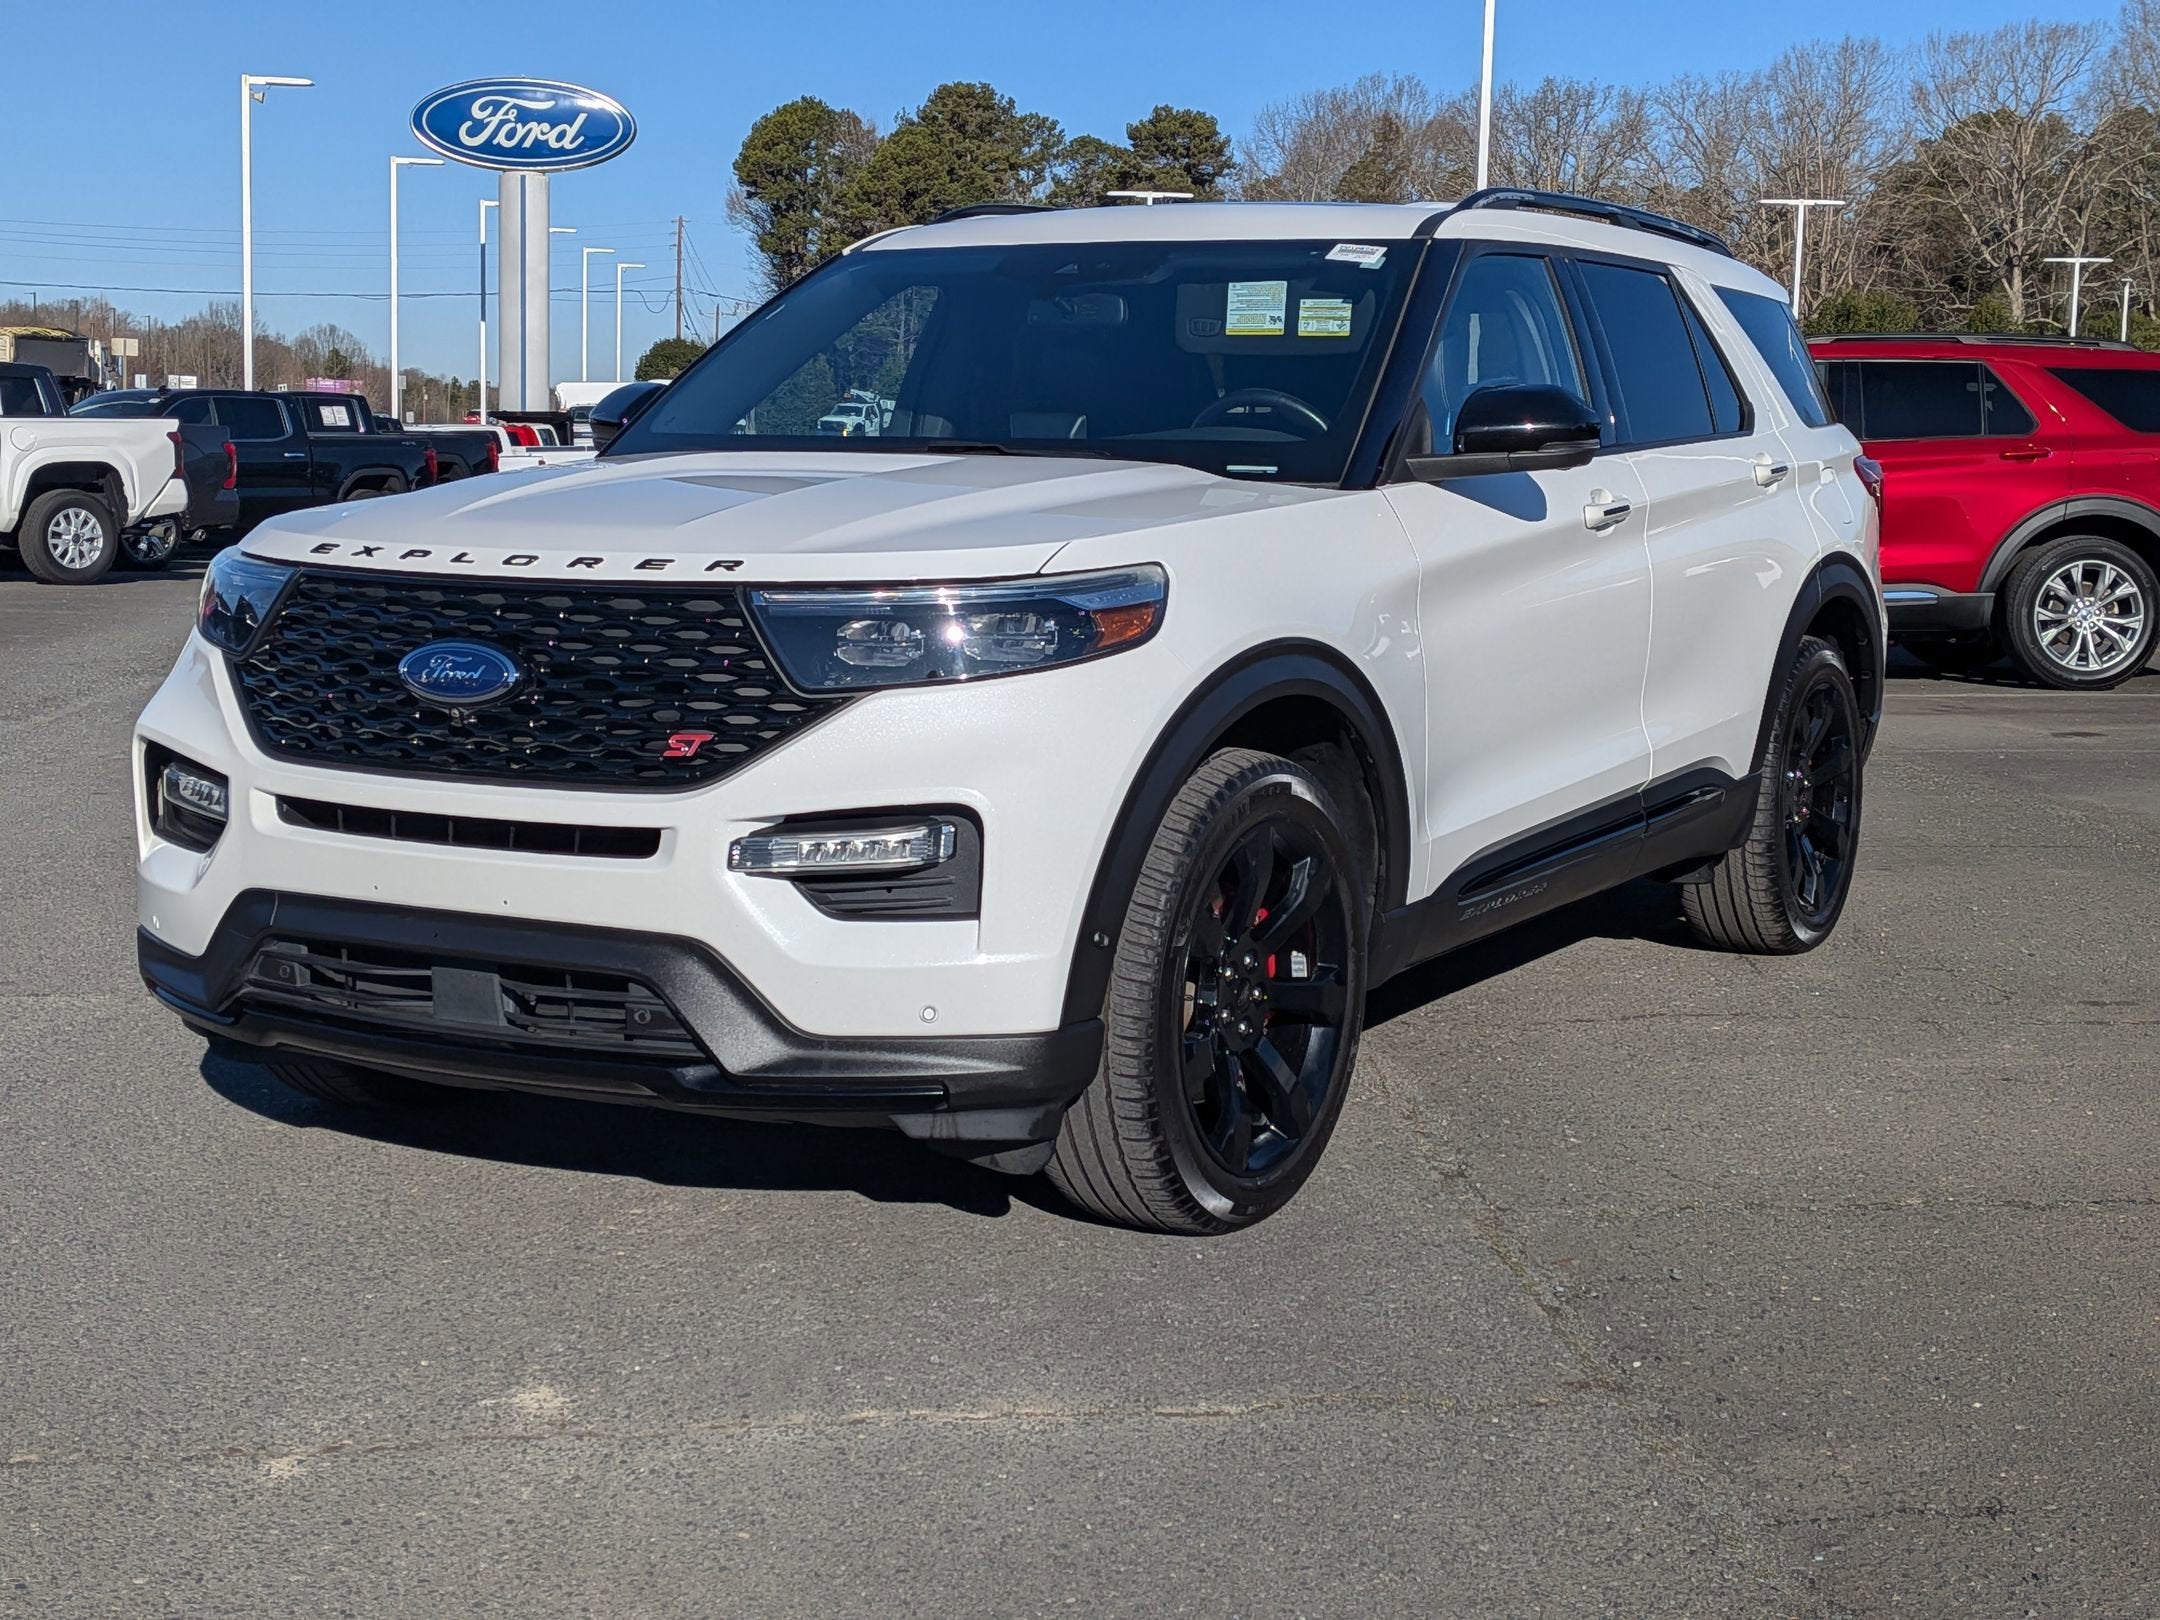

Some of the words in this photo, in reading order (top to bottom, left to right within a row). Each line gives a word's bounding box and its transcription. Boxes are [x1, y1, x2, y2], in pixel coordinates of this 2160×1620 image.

[458, 95, 588, 150] Ford
[309, 542, 745, 573] EXPLORER
[420, 653, 487, 686] Ford
[662, 734, 715, 757] ST
